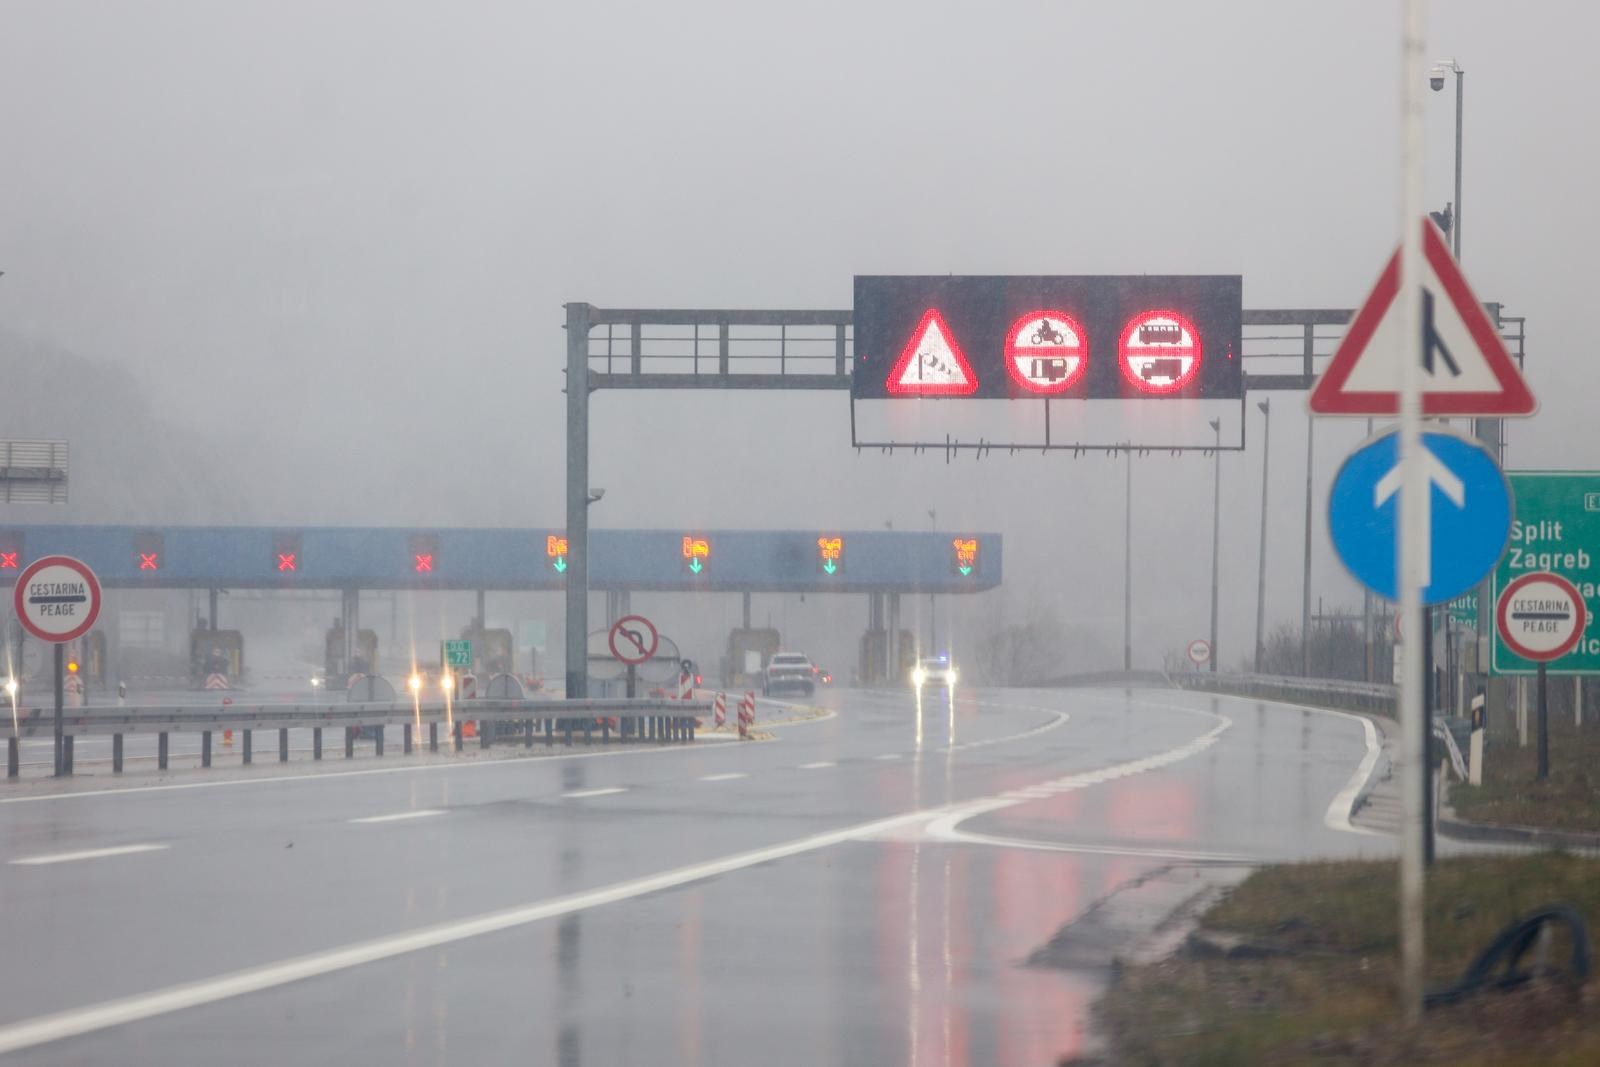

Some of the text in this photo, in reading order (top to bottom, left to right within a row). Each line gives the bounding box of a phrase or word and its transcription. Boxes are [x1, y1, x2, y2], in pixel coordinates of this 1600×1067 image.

[1511, 520, 1562, 545] Split
[1509, 548, 1590, 571] Zagreb
[30, 583, 85, 595] CESTARINA
[40, 604, 75, 616] PEAGE
[1513, 600, 1570, 611] CESTARINA
[1523, 621, 1559, 633] PEAGE
